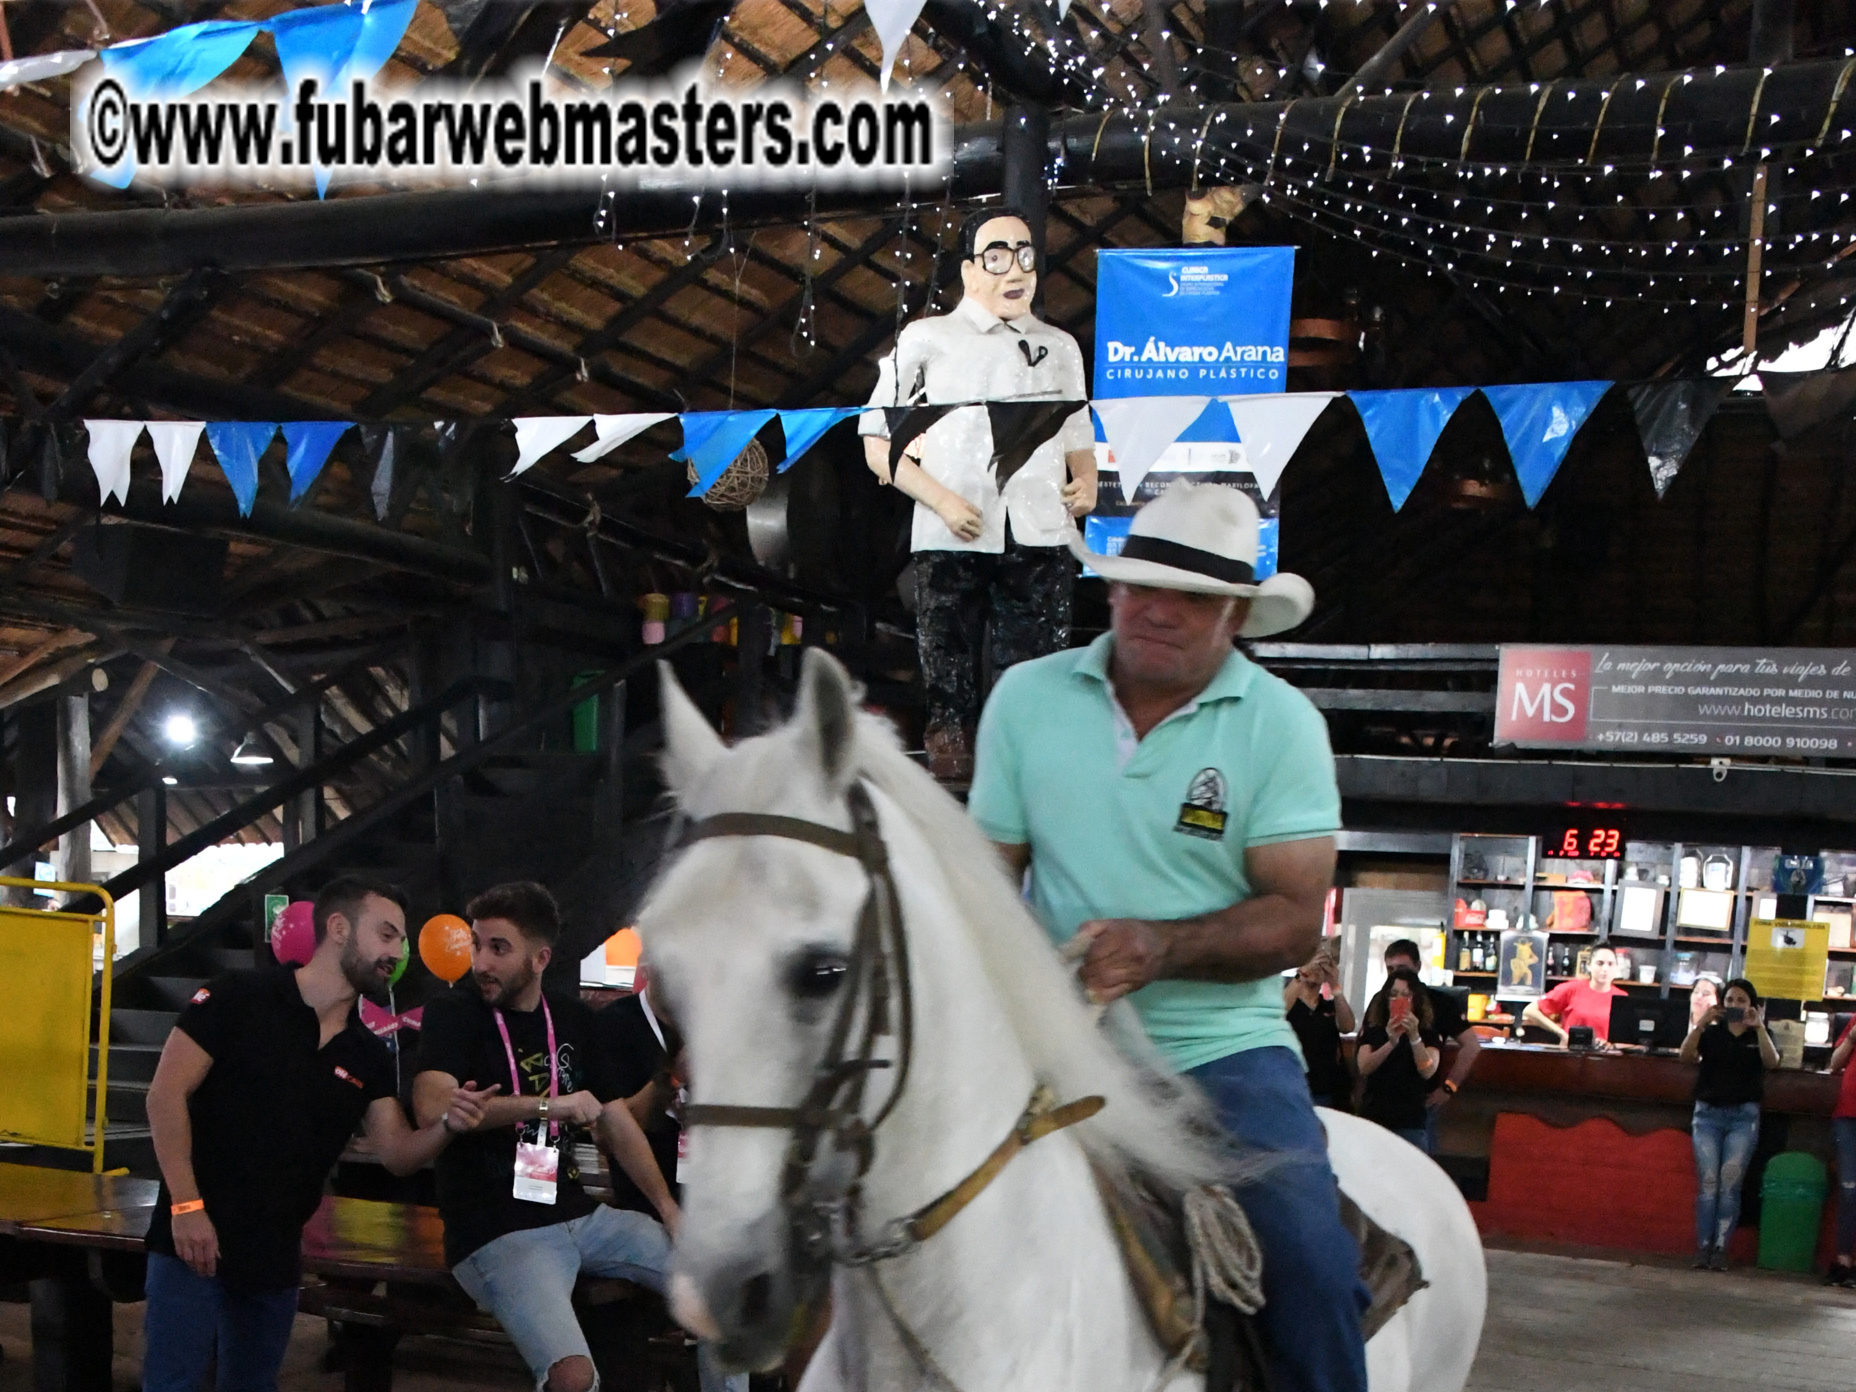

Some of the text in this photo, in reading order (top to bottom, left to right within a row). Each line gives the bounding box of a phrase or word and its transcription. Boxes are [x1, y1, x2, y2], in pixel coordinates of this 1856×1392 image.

[1107, 336, 1285, 362] Dr. Álvaro Arana
[1107, 367, 1279, 380] CIRUJANO PLÁSTICO
[1516, 669, 1577, 678] HOTELES
[1594, 652, 1852, 683] La mejor opción para tus viajes de
[1612, 685, 1645, 694] MEJOR
[1648, 685, 1685, 695] PRECIO
[1688, 686, 1761, 697] GARANTIZADO
[1763, 688, 1786, 698] POR
[1788, 689, 1823, 699] MEDIO
[1826, 690, 1840, 699] DE
[1510, 682, 1576, 723] MS
[1597, 731, 1838, 750] +57(2) 485 5259 01 8000 910098
